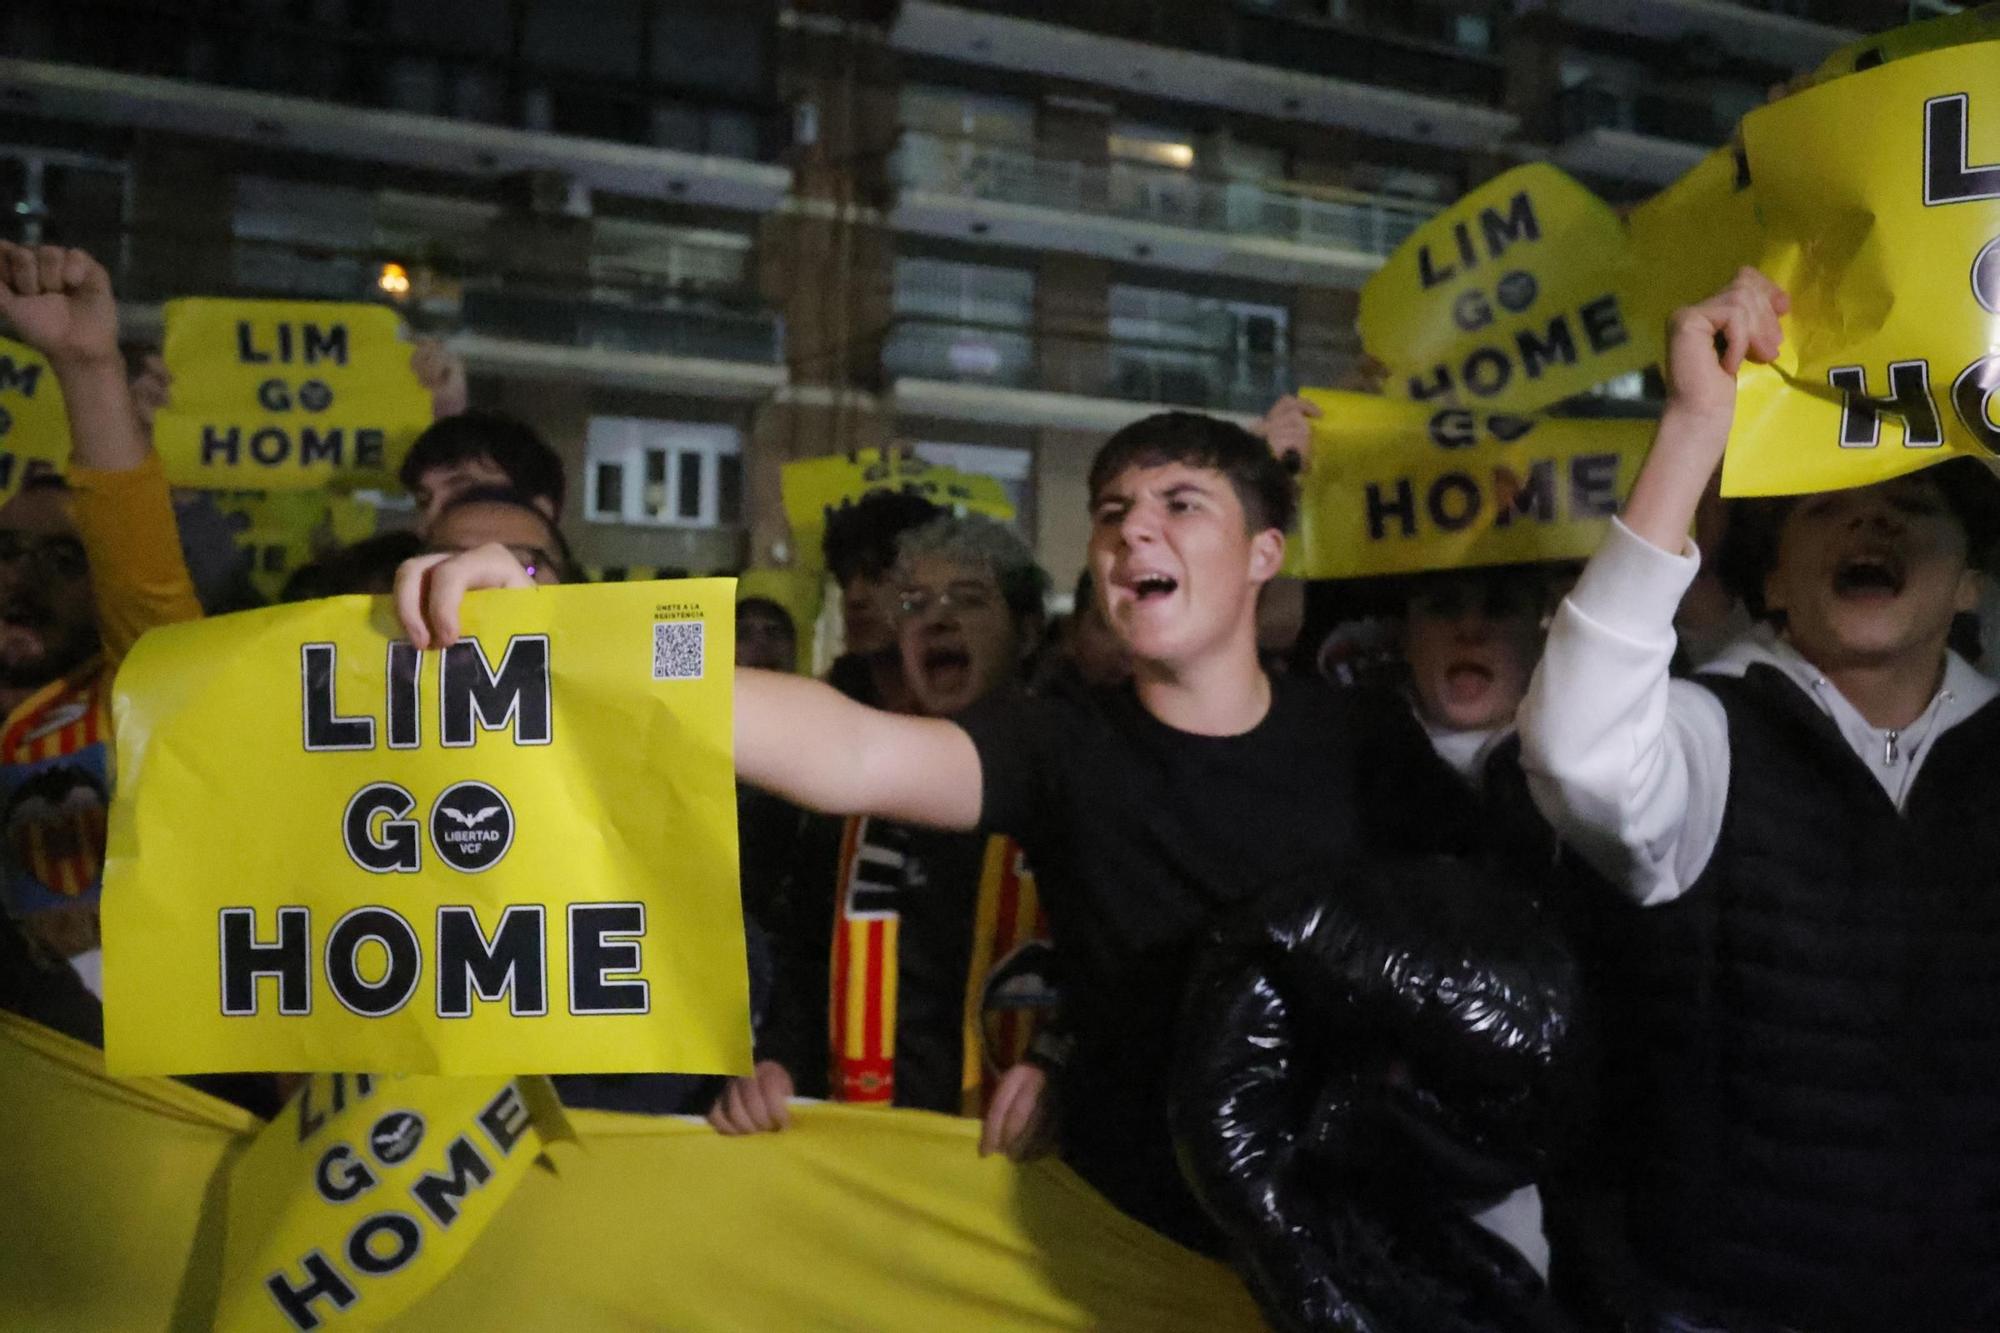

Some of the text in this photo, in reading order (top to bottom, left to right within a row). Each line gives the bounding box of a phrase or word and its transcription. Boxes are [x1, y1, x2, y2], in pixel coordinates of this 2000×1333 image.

[1417, 190, 1541, 290] LIM
[237, 319, 348, 368] LIM
[201, 426, 385, 469] HOME
[1365, 451, 1622, 541] HOME
[301, 634, 553, 752] LIM
[342, 780, 515, 874] GO
[444, 829, 500, 842] LIBERTAD
[460, 842, 482, 855] VCF
[219, 902, 650, 1018] HOME
[315, 1109, 426, 1206] GO
[265, 1082, 532, 1333] HOME
